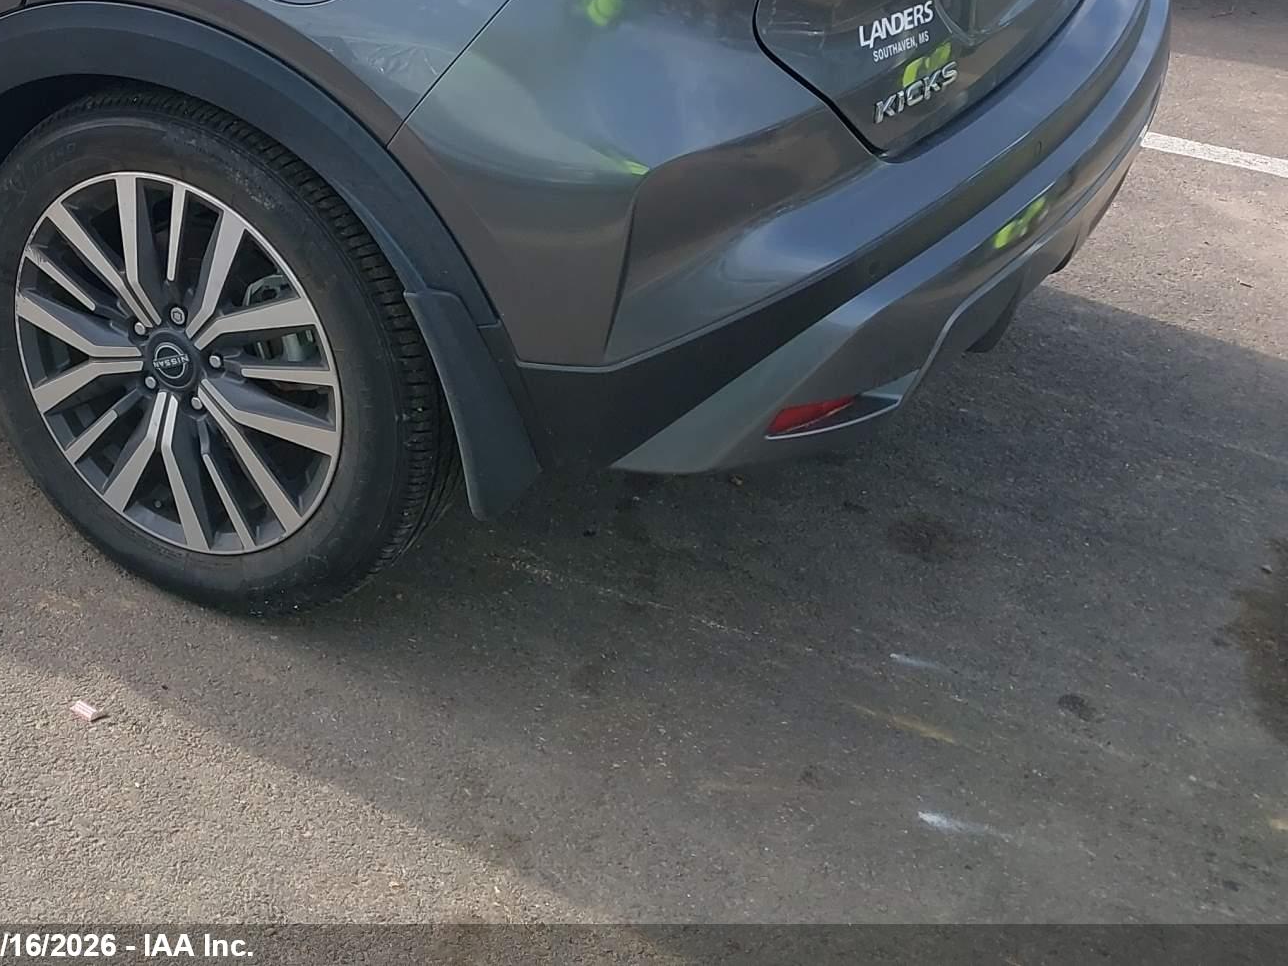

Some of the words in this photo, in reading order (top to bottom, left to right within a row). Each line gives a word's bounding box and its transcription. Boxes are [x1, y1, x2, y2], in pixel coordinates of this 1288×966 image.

[859, 0, 933, 48] LANDERS
[873, 36, 918, 62] SOUTHAVEN,
[918, 30, 930, 44] MS
[873, 61, 958, 124] KICKS
[153, 354, 190, 369] NISSAN
